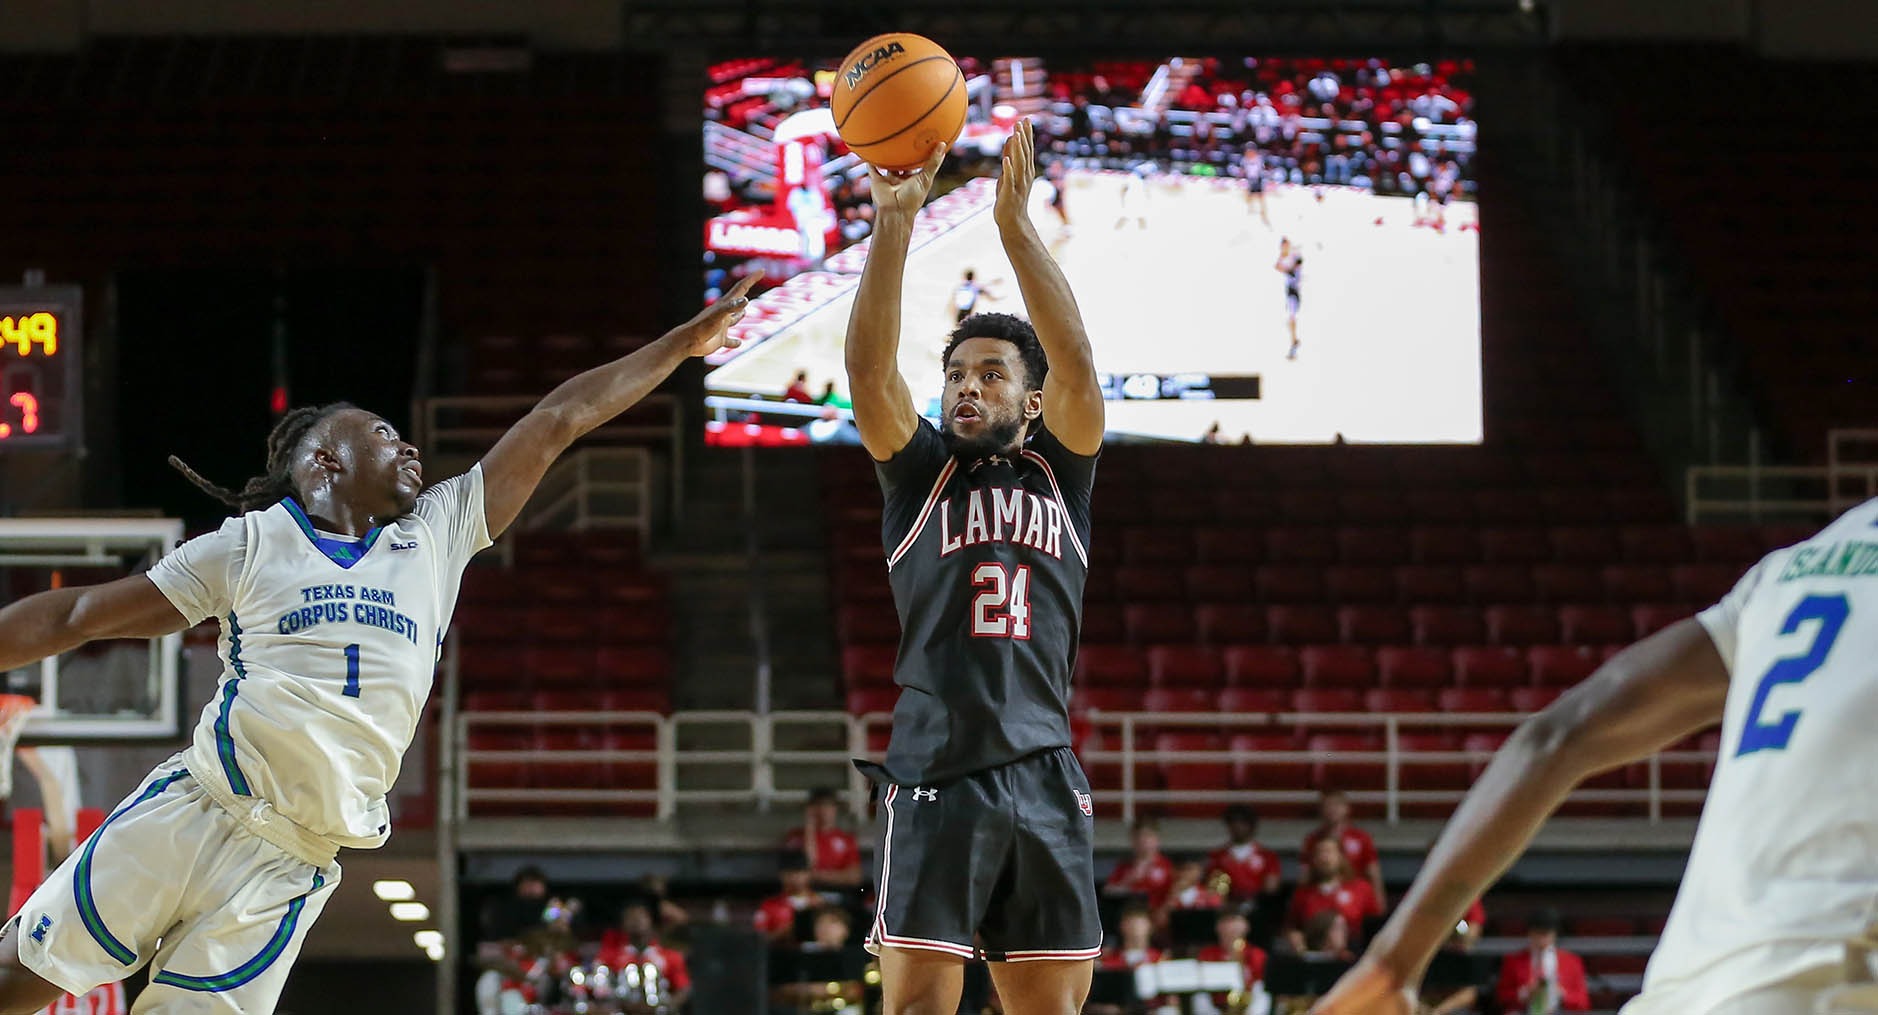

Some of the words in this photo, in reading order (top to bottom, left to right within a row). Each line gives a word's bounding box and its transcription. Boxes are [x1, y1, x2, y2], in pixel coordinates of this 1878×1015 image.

[845, 42, 905, 90] NCAA
[390, 541, 418, 551] SLC
[940, 487, 1062, 560] LAMAR
[301, 584, 355, 603] TEXAS
[361, 587, 396, 607] A&M
[971, 562, 1030, 640] 24
[278, 602, 348, 635] CORPUS
[354, 604, 418, 646] CHRISTI
[341, 643, 361, 698] 1
[1735, 591, 1850, 757] 2
